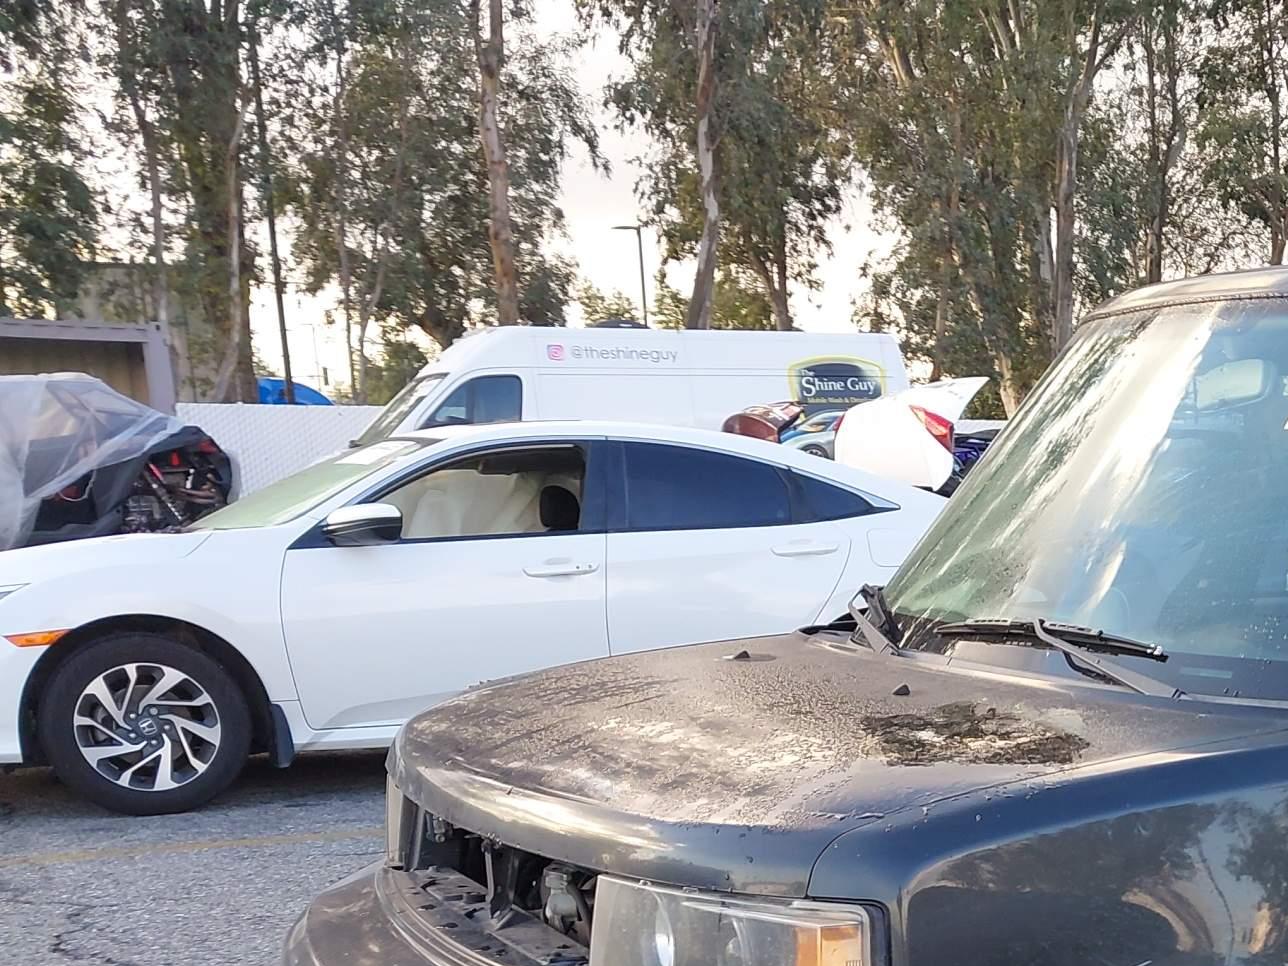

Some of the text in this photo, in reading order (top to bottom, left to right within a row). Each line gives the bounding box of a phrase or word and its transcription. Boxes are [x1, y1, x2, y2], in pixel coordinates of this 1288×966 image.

[571, 345, 678, 363] @theshineguy
[801, 377, 876, 397] Shine Guy
